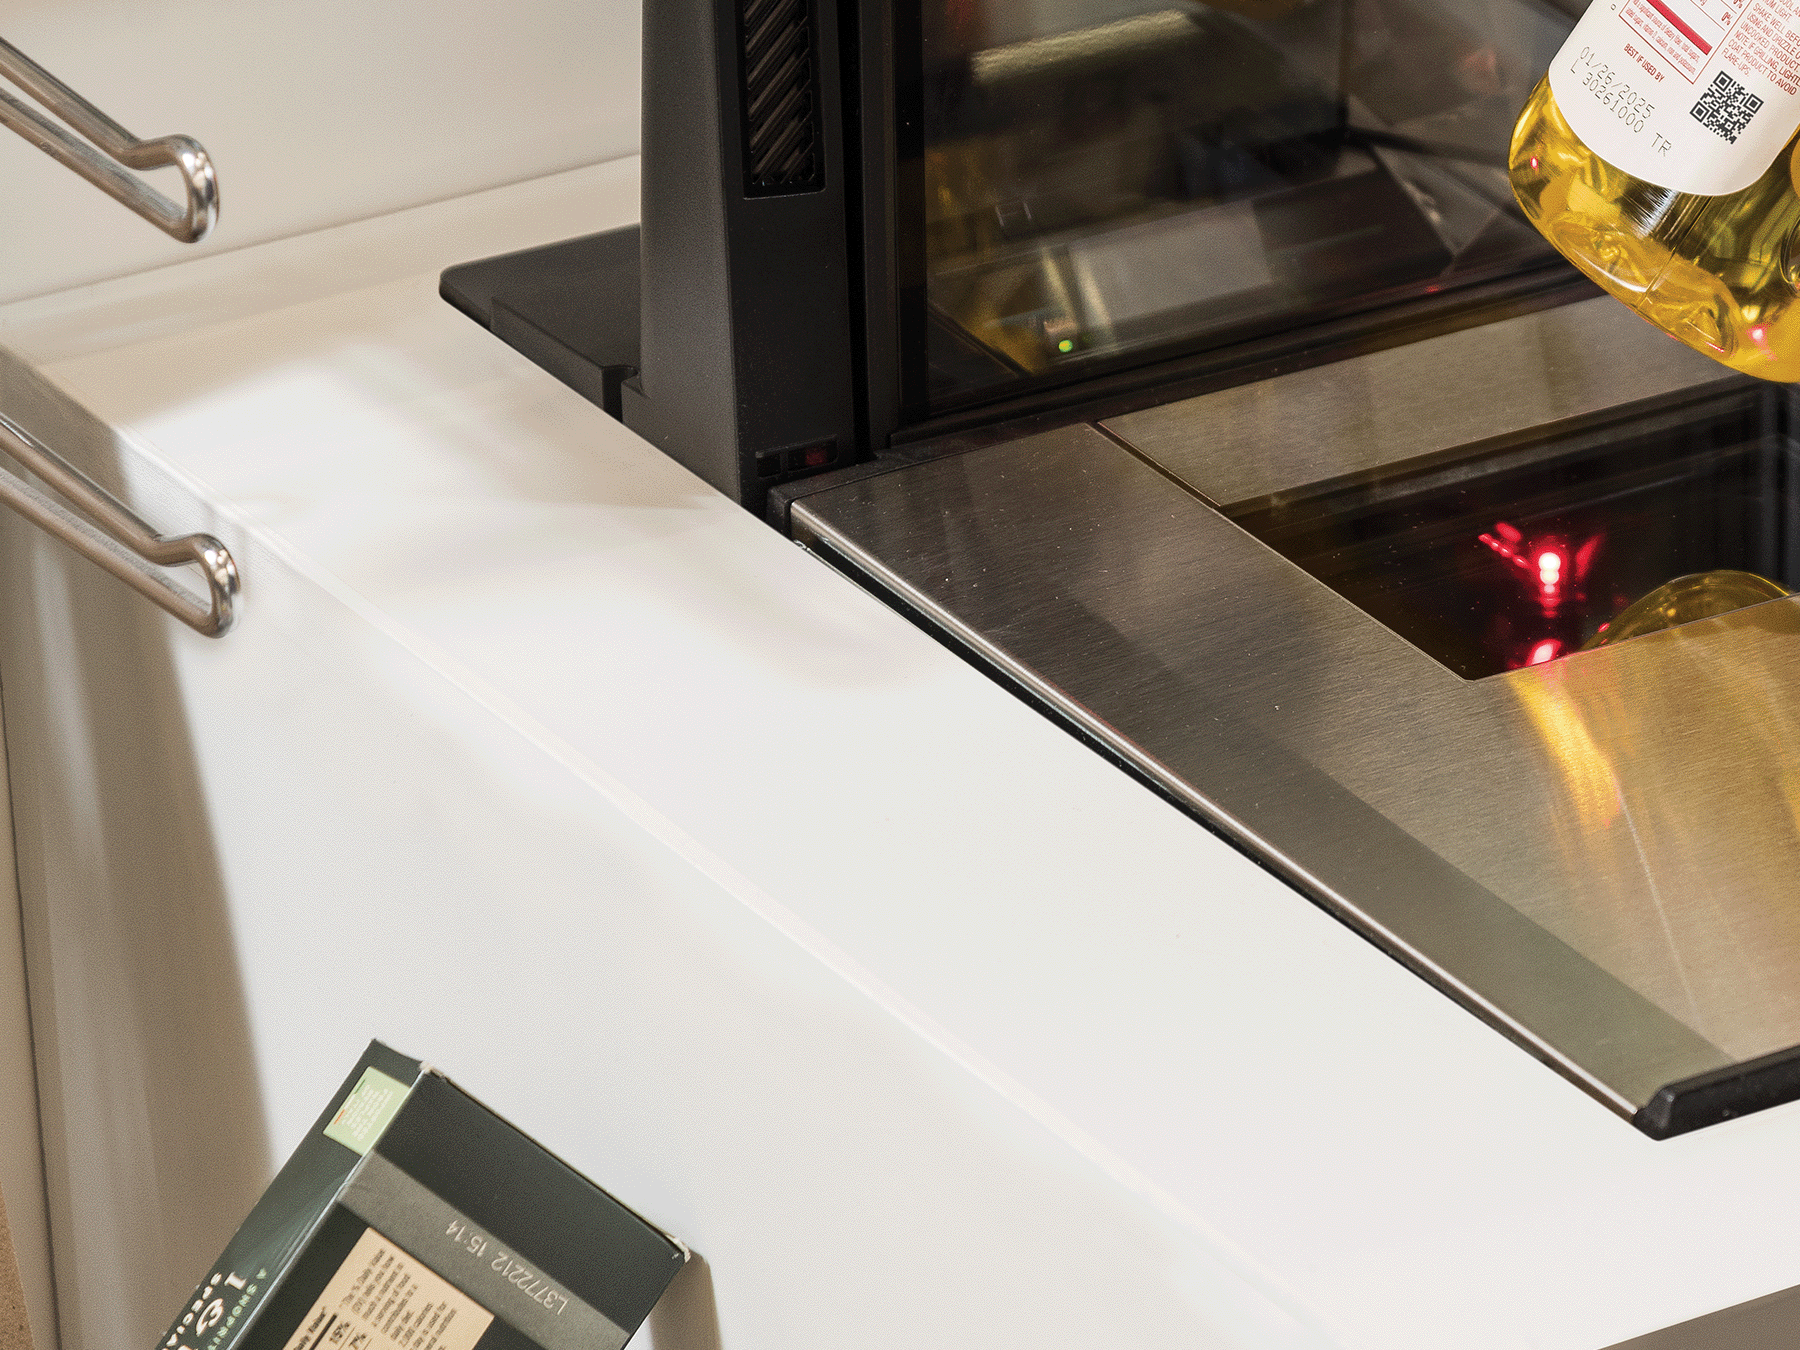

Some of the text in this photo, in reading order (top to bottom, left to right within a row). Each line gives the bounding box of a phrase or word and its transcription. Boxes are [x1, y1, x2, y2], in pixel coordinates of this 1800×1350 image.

[1721, 11, 1733, 26] 0%
[1769, 17, 1786, 34] WELL
[1624, 43, 1639, 59] BEST
[1641, 59, 1657, 76] USED
[1654, 71, 1665, 83] BY
[1739, 20, 1800, 73] UNCOOKED PRODUCT.
[1771, 33, 1797, 56] DRIZZLE
[1579, 45, 1655, 120] 01/26/2025
[1740, 49, 1797, 96] PRODUCT TO AVOID
[1581, 71, 1673, 158] 30261000 TR
[443, 1217, 489, 1258] 15:14
[488, 1249, 570, 1317] L3772212
[162, 1272, 222, 1350] SPECIA
[207, 1283, 258, 1350] SHOPRIT
